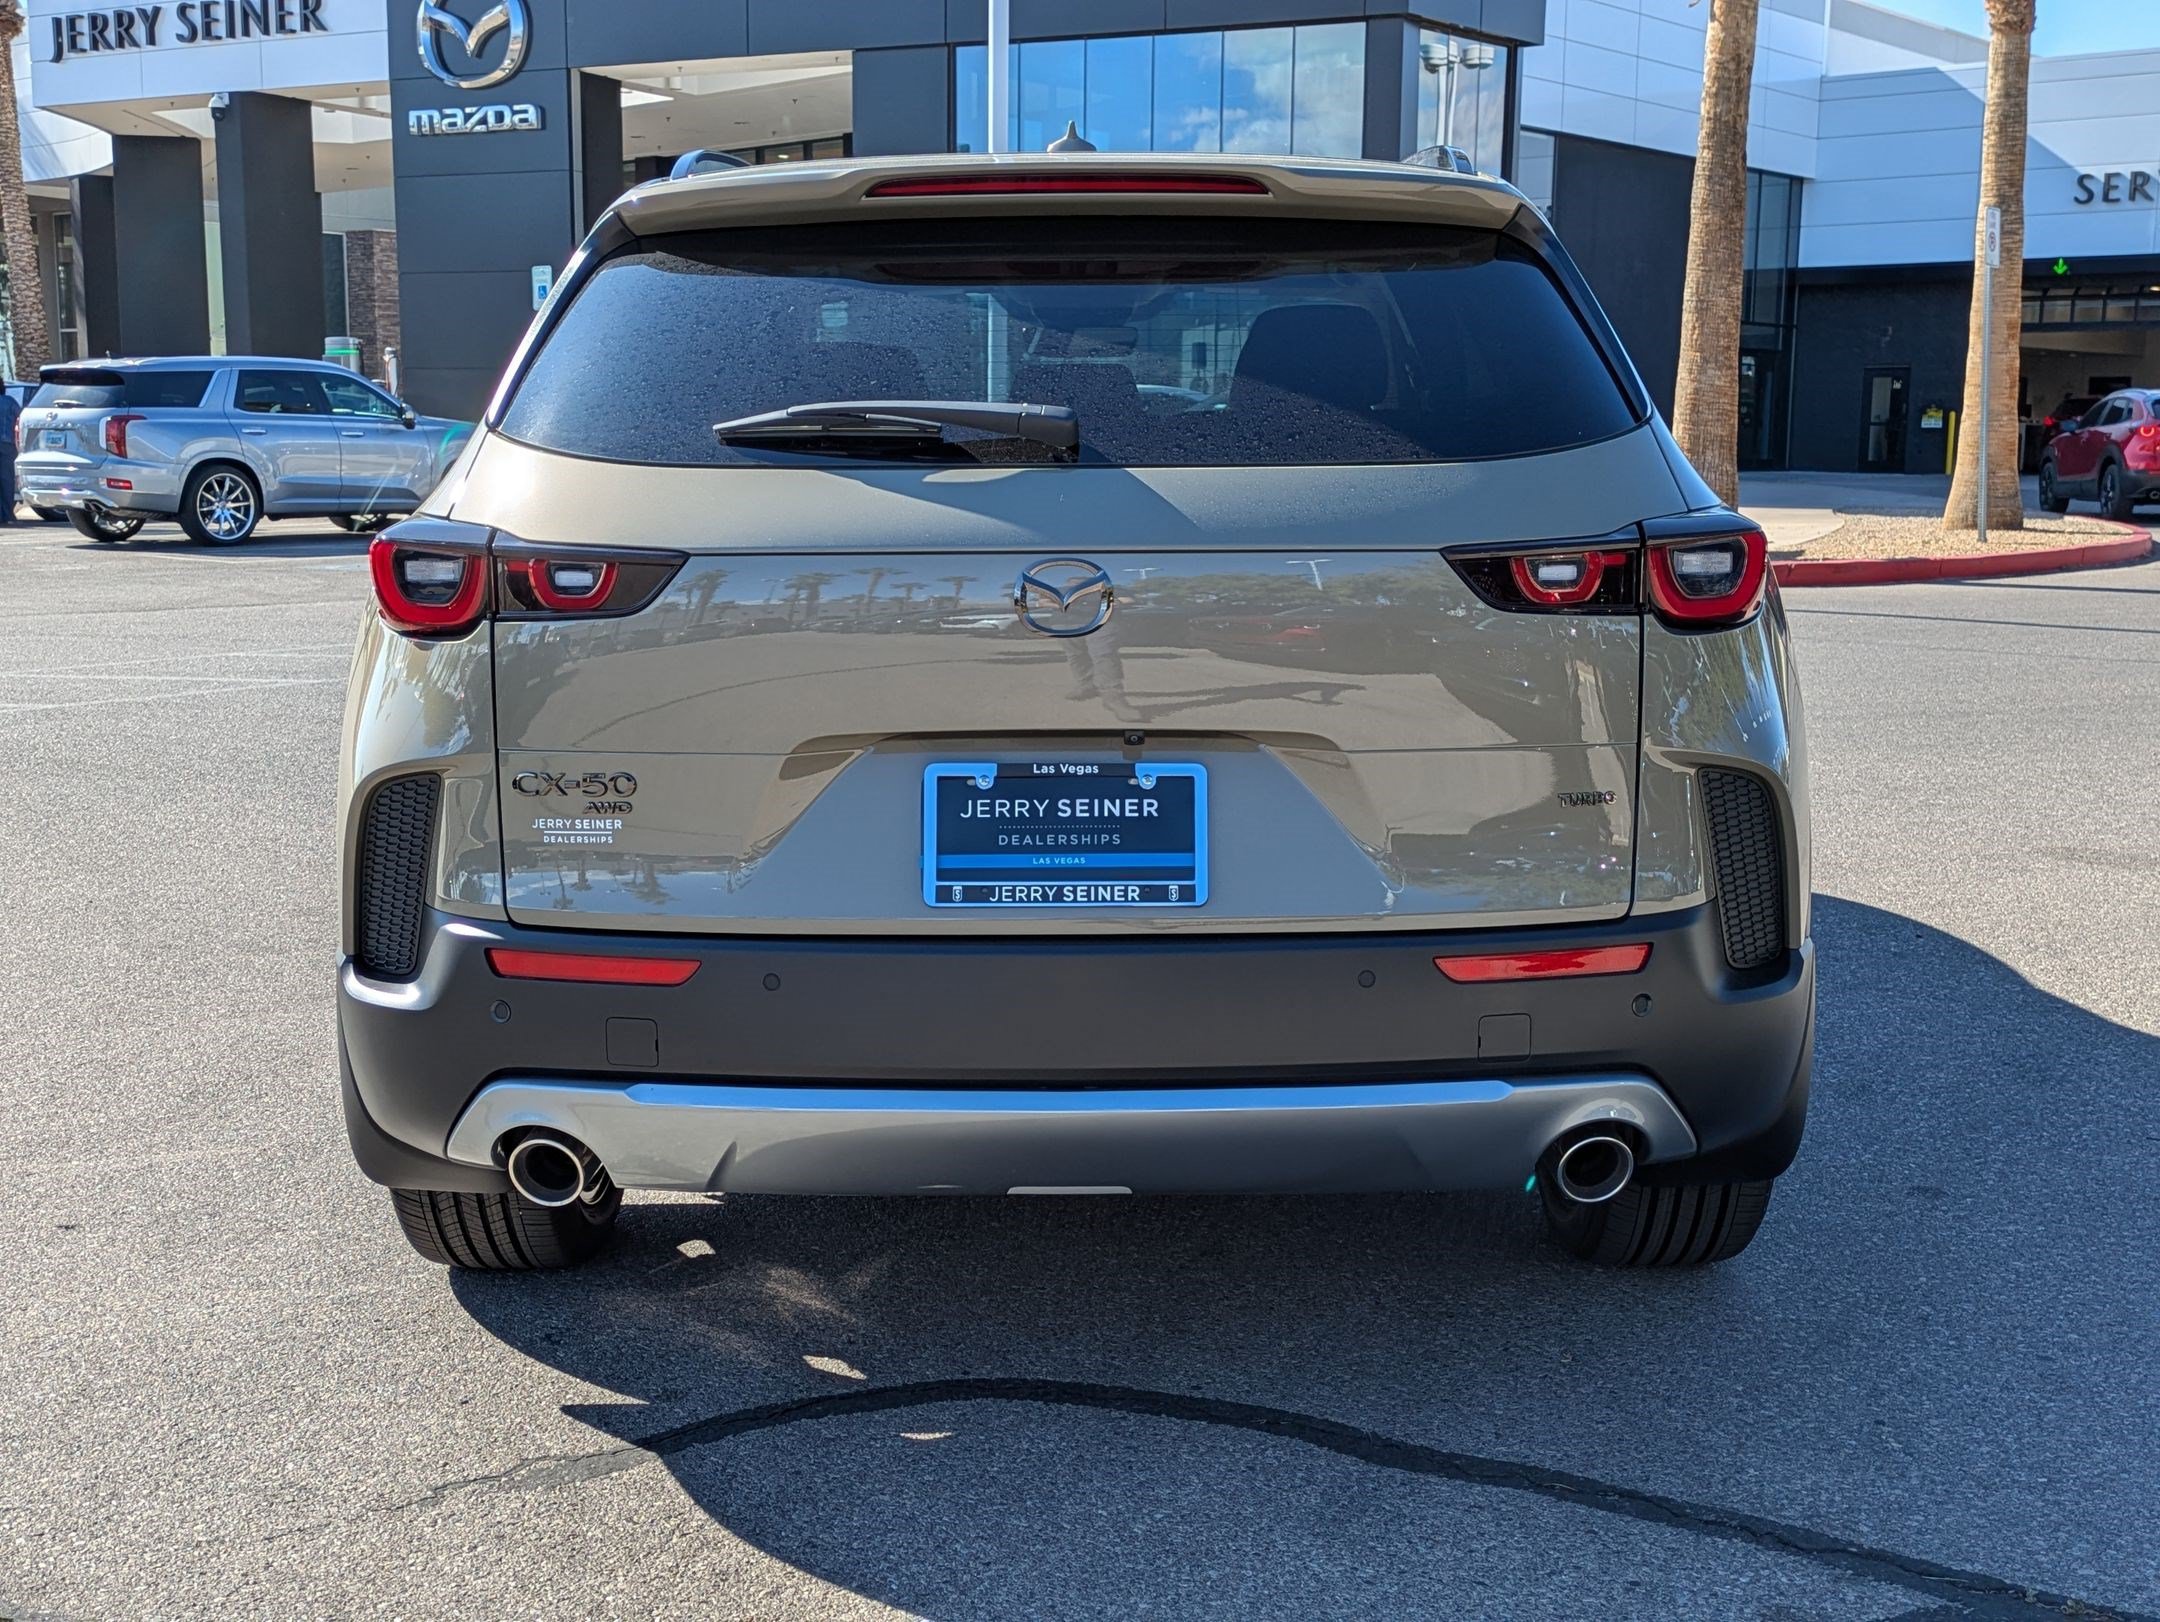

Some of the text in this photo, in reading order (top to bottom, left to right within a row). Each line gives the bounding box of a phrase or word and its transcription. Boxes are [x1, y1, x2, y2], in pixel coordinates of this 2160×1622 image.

[50, 0, 328, 63] JERRY SEINER
[2073, 170, 2160, 206] SER
[1033, 763, 1099, 776] Las Vegas
[511, 770, 638, 798] CX-50
[1557, 790, 1617, 808] TURBO
[582, 800, 633, 815] AWD
[960, 798, 1159, 818] JERRY SEINER
[532, 818, 622, 829] JERRY SEINER
[543, 835, 613, 844] DEALERSHIPS
[998, 834, 1122, 846] DEALERSHIPS
[1032, 857, 1086, 865] LAS VEGAS
[989, 886, 1140, 902] JERRY SEINER
